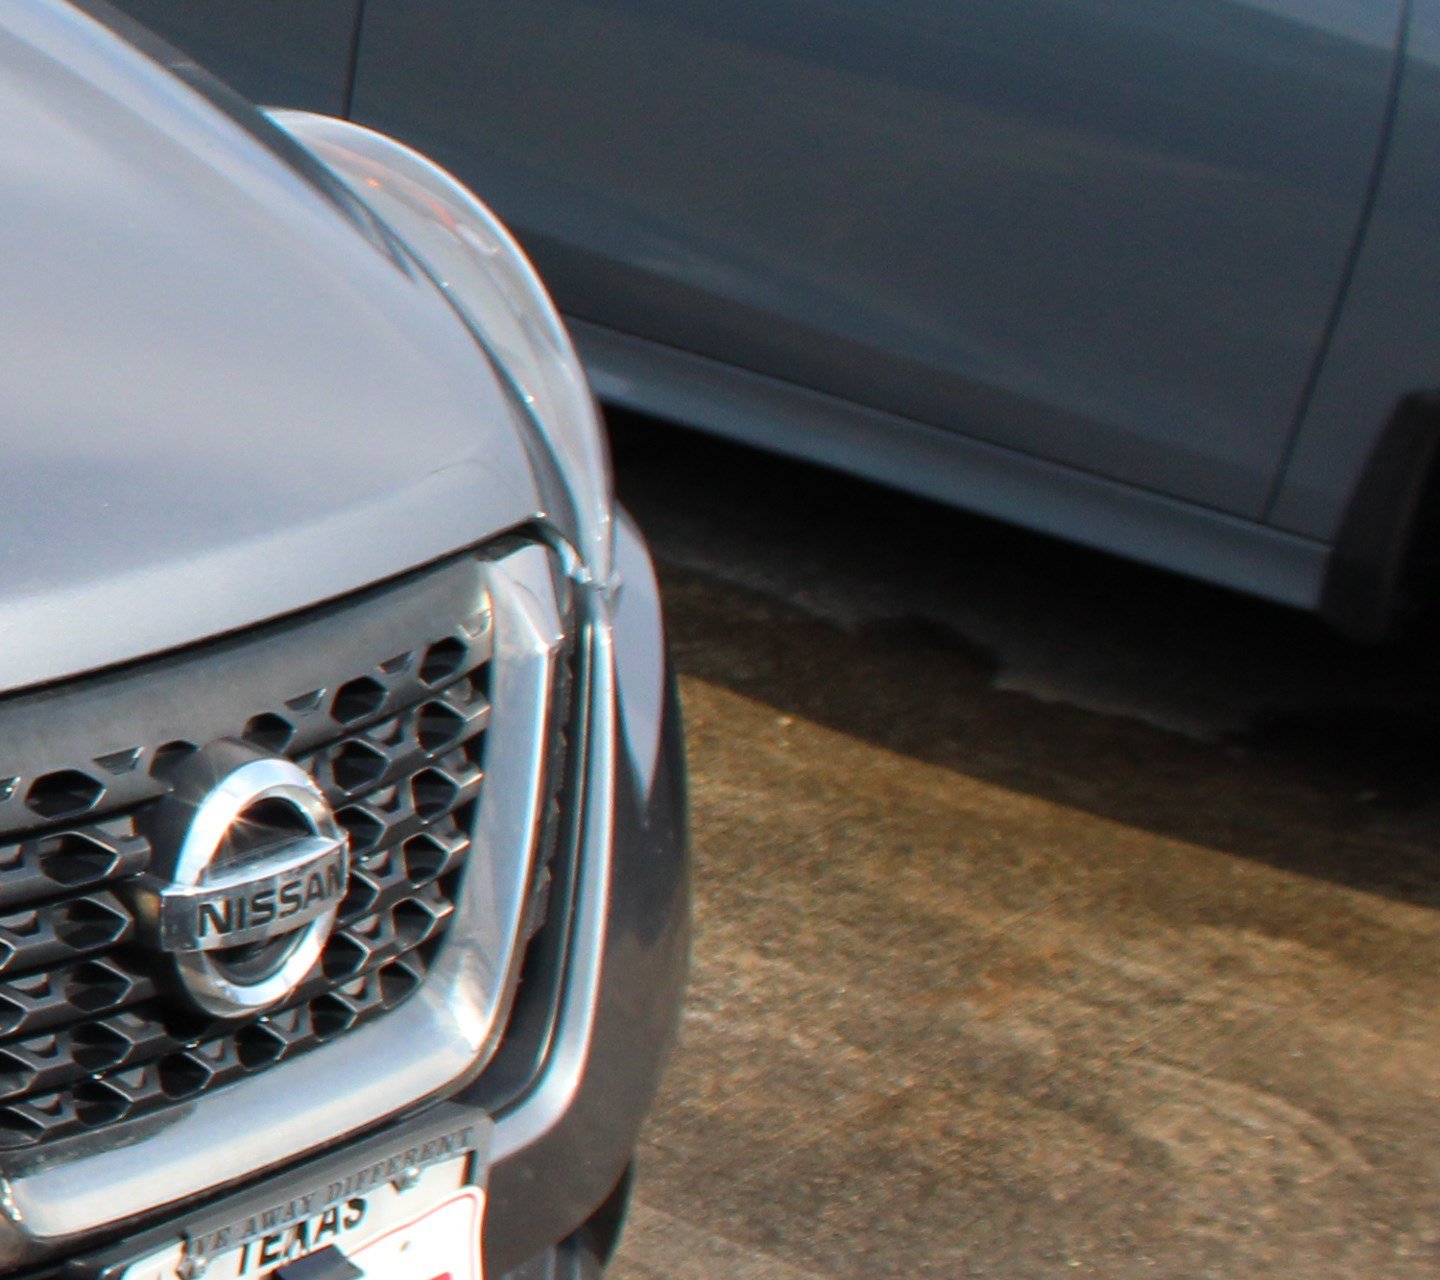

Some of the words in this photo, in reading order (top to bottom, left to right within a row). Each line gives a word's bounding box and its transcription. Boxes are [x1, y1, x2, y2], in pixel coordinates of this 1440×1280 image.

[198, 863, 344, 939] NISSAN
[239, 1191, 317, 1239] AWAY
[325, 1126, 474, 1204] DIFFERENT
